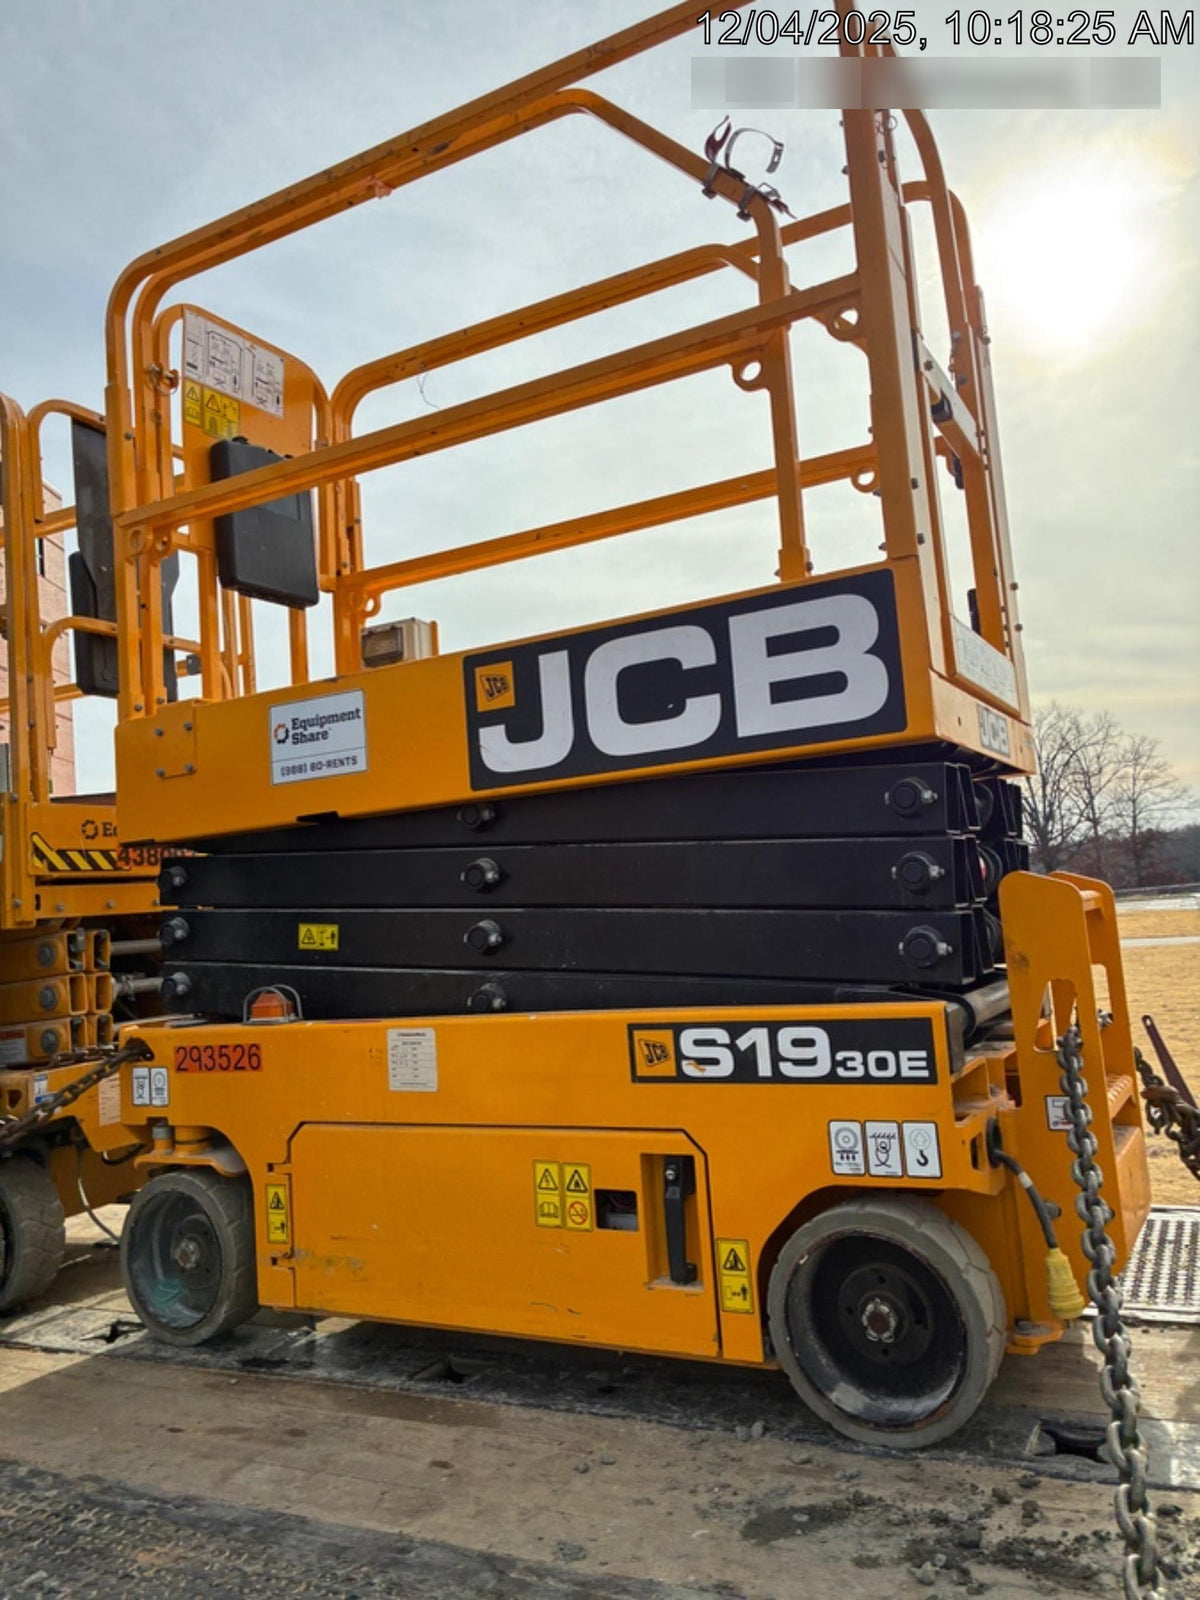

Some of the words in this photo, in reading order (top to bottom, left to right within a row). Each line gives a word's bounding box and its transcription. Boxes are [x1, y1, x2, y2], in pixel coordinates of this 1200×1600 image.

[479, 594, 889, 773] JCB
[483, 676, 508, 698] JCB
[291, 708, 362, 731] Equipment
[291, 730, 330, 745] Share
[176, 1043, 261, 1072] 293526
[642, 1041, 669, 1065] JCB
